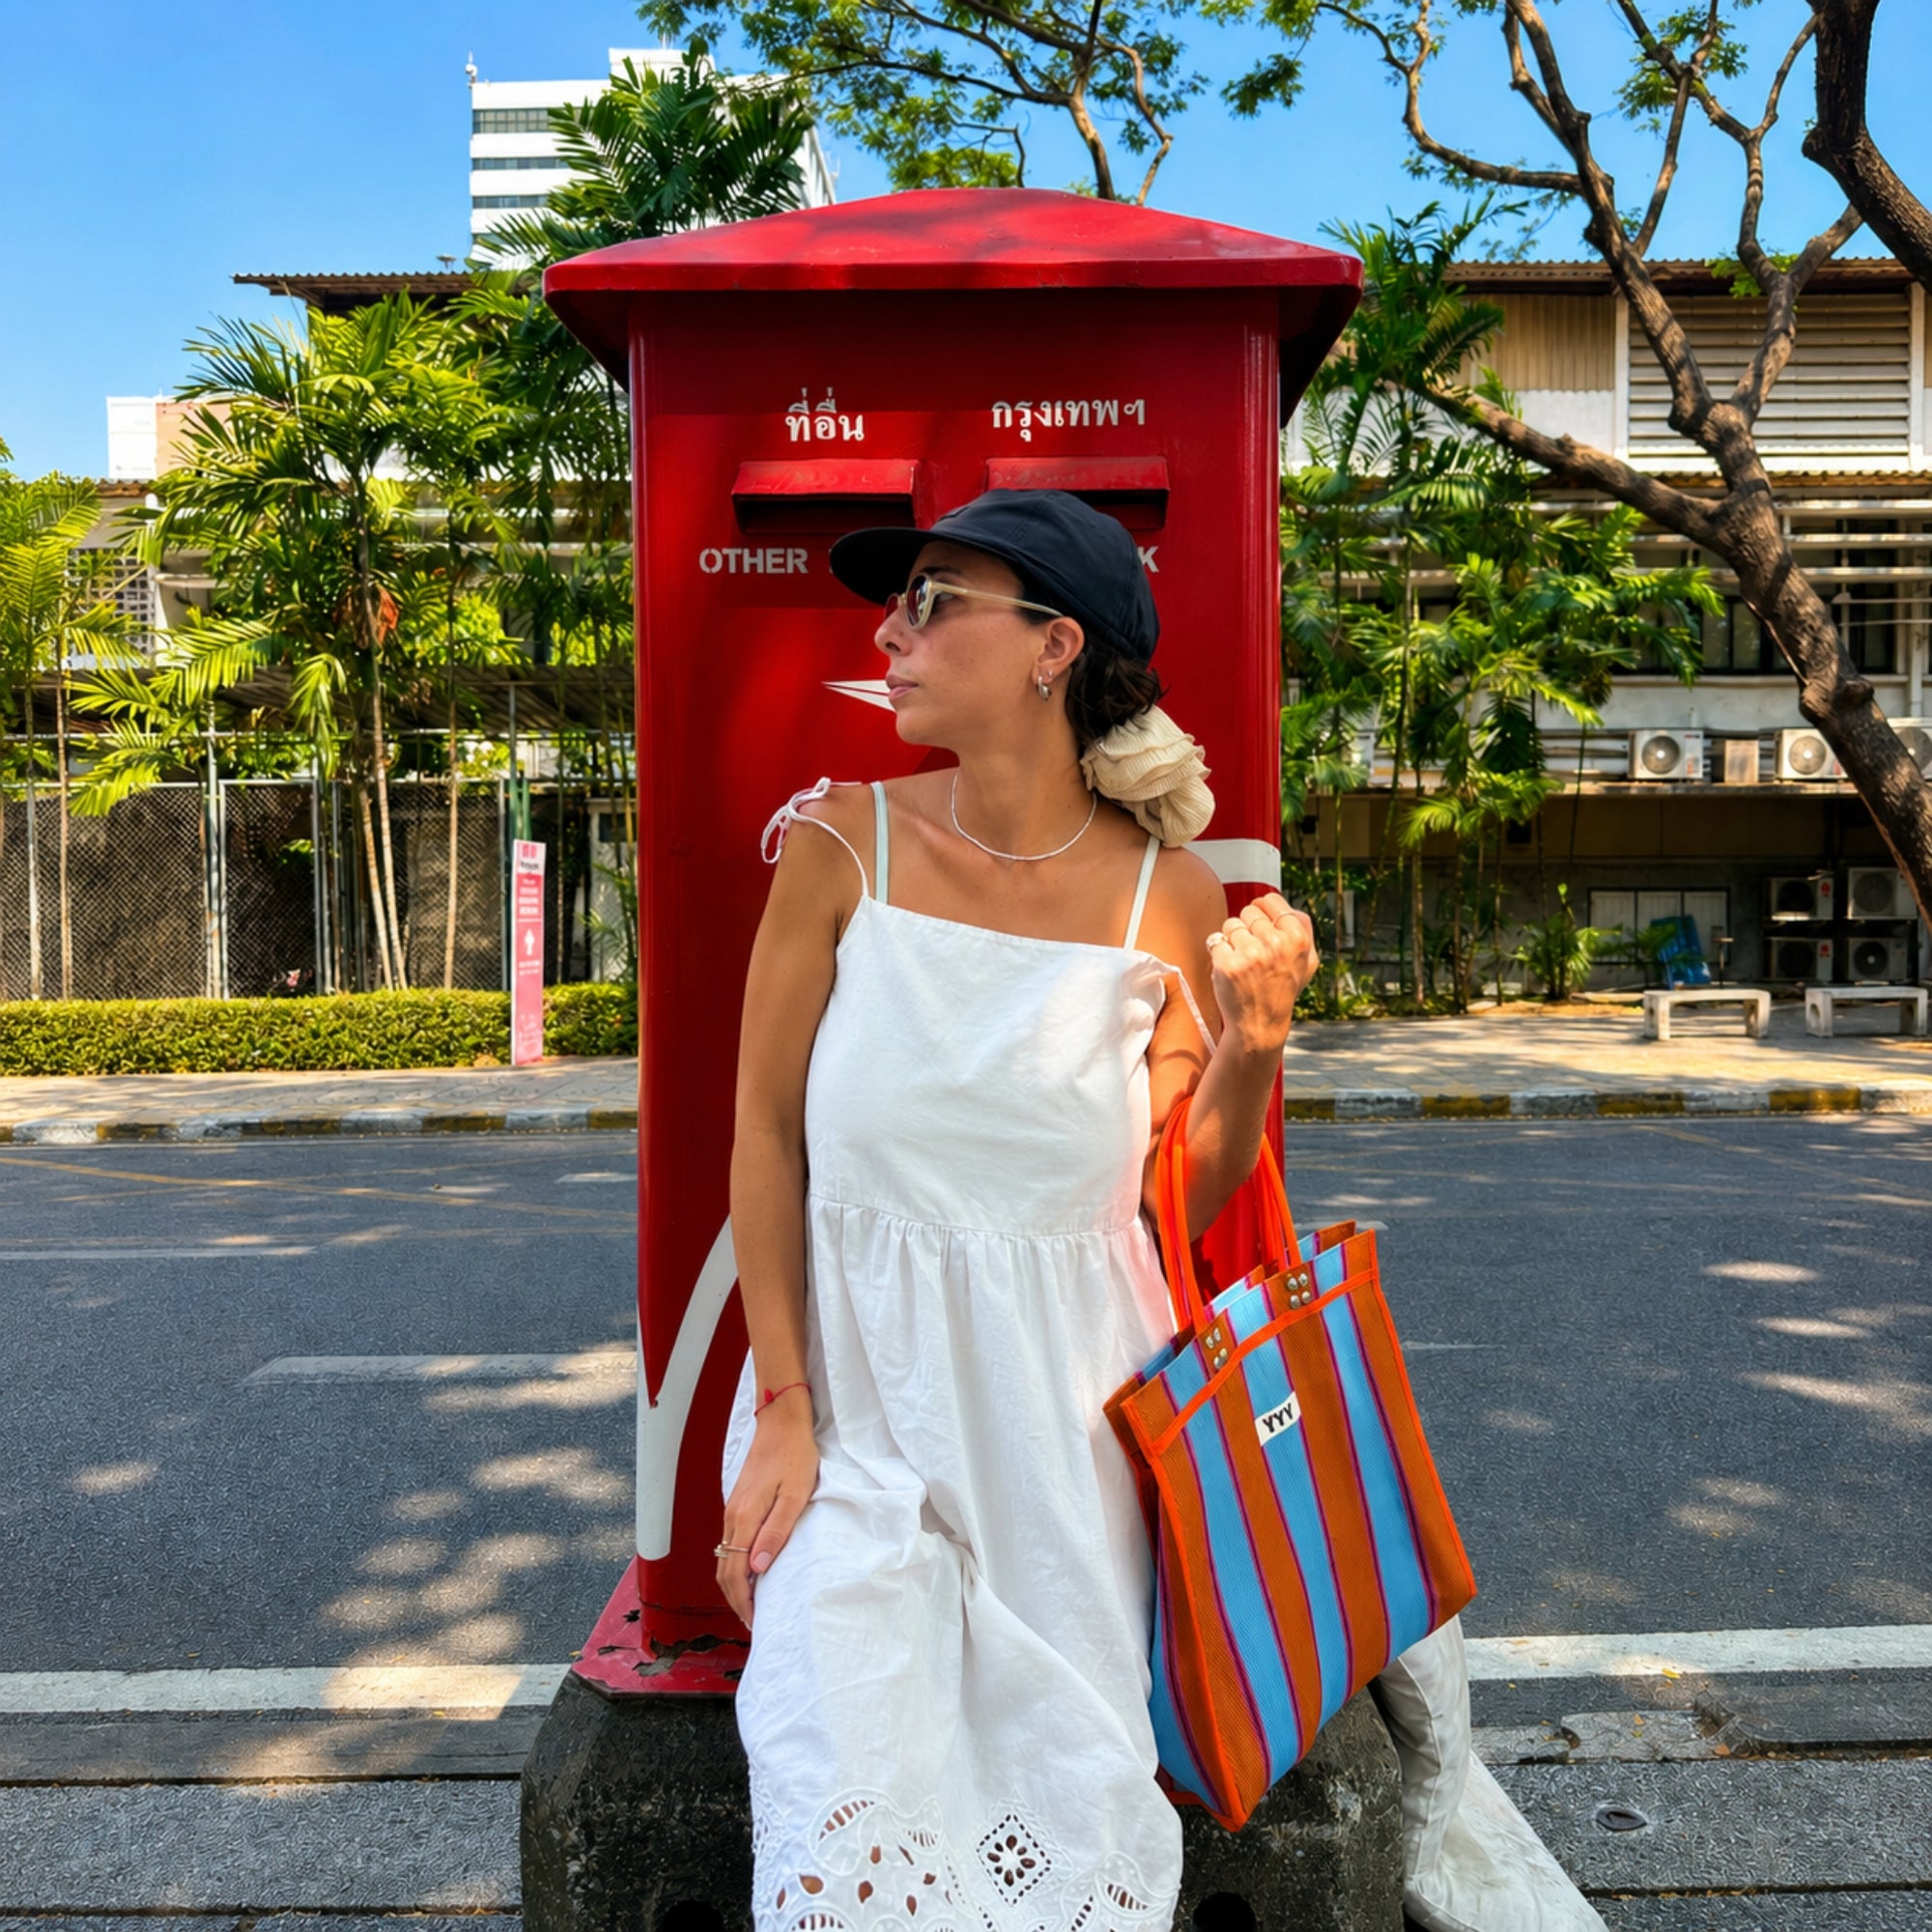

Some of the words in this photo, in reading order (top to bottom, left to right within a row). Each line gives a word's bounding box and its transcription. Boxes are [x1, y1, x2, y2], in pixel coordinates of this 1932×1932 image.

[785, 386, 865, 442] ที่อื่น
[991, 399, 1145, 442] กรุงเทพฯ
[698, 547, 810, 575] OTHER
[1262, 1402, 1293, 1434] YYY
